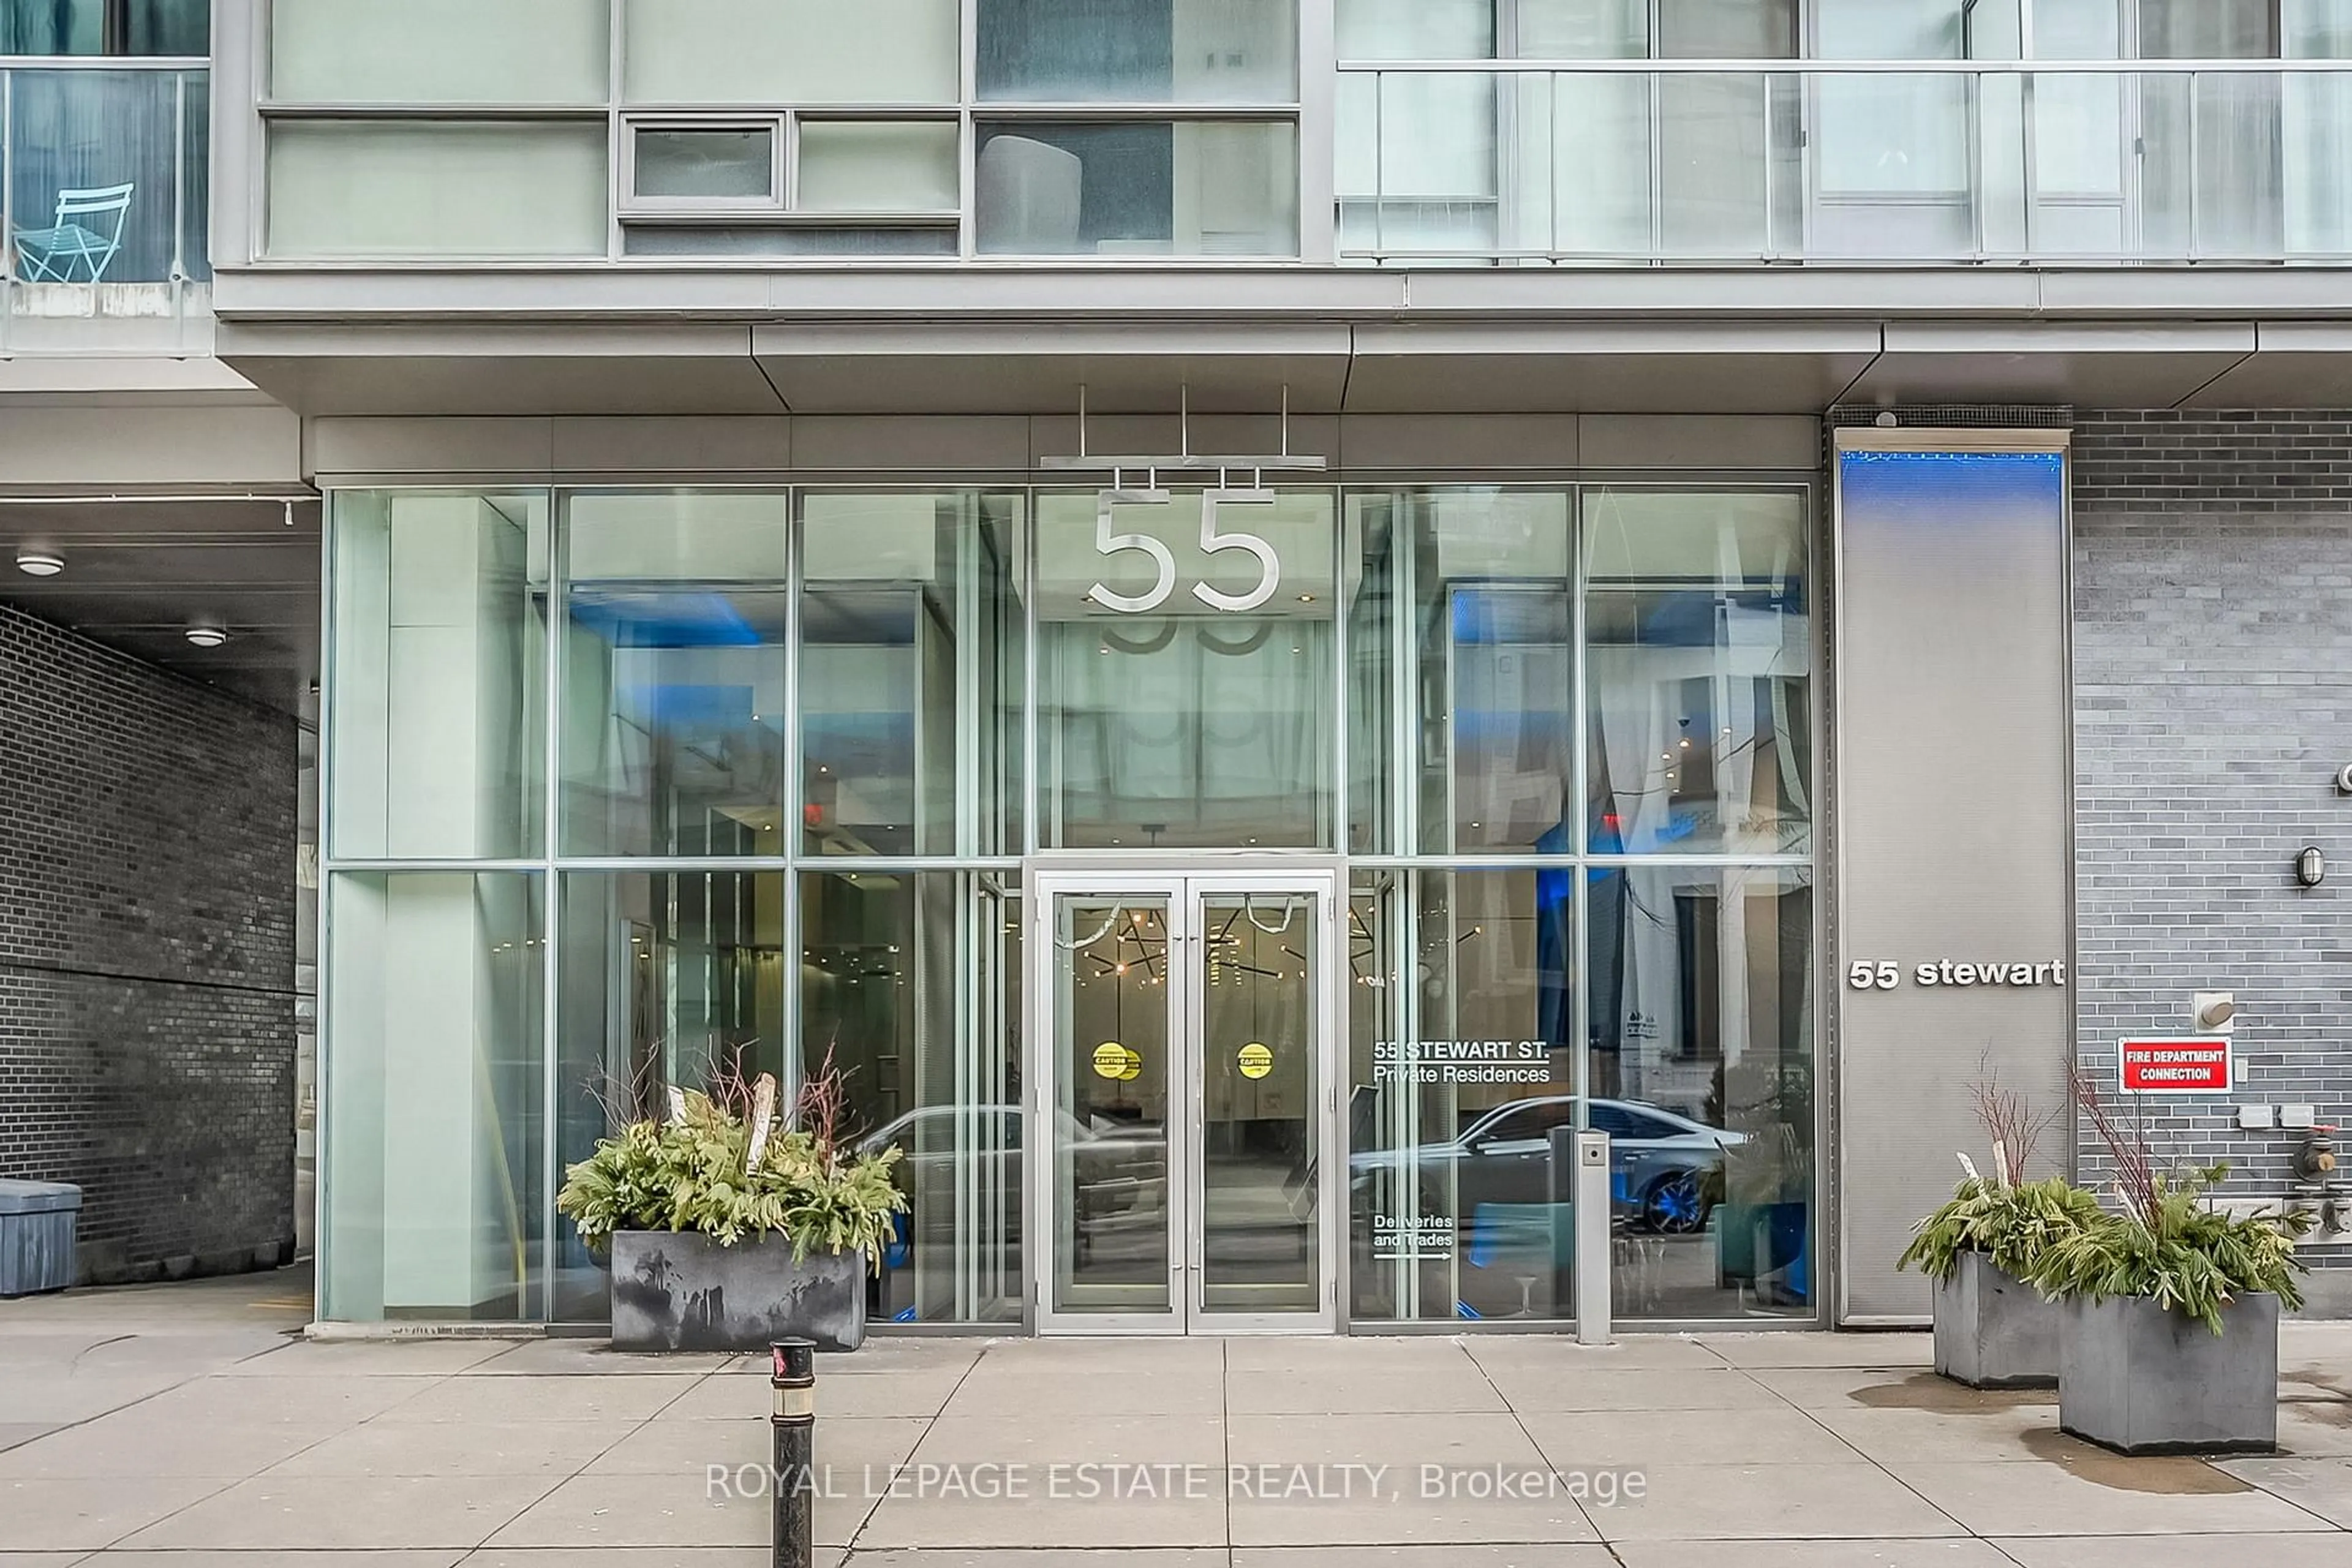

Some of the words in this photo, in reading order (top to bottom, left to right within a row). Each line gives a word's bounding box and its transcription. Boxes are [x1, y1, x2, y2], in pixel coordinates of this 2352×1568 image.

[1088, 489, 1280, 613] 55
[1849, 960, 1899, 989] 55
[1917, 958, 2066, 985] stewart
[1374, 1041, 1399, 1058] 55
[1406, 1041, 1512, 1058] STEWART
[1518, 1041, 1550, 1058] ST.
[2127, 1051, 2150, 1062] FIRE
[2154, 1050, 2224, 1062] DEPARTMENT
[1374, 1066, 1438, 1082] Private
[1443, 1066, 1550, 1082] Residences
[2141, 1068, 2211, 1080] CONNECTION
[1374, 1234, 1400, 1246] and
